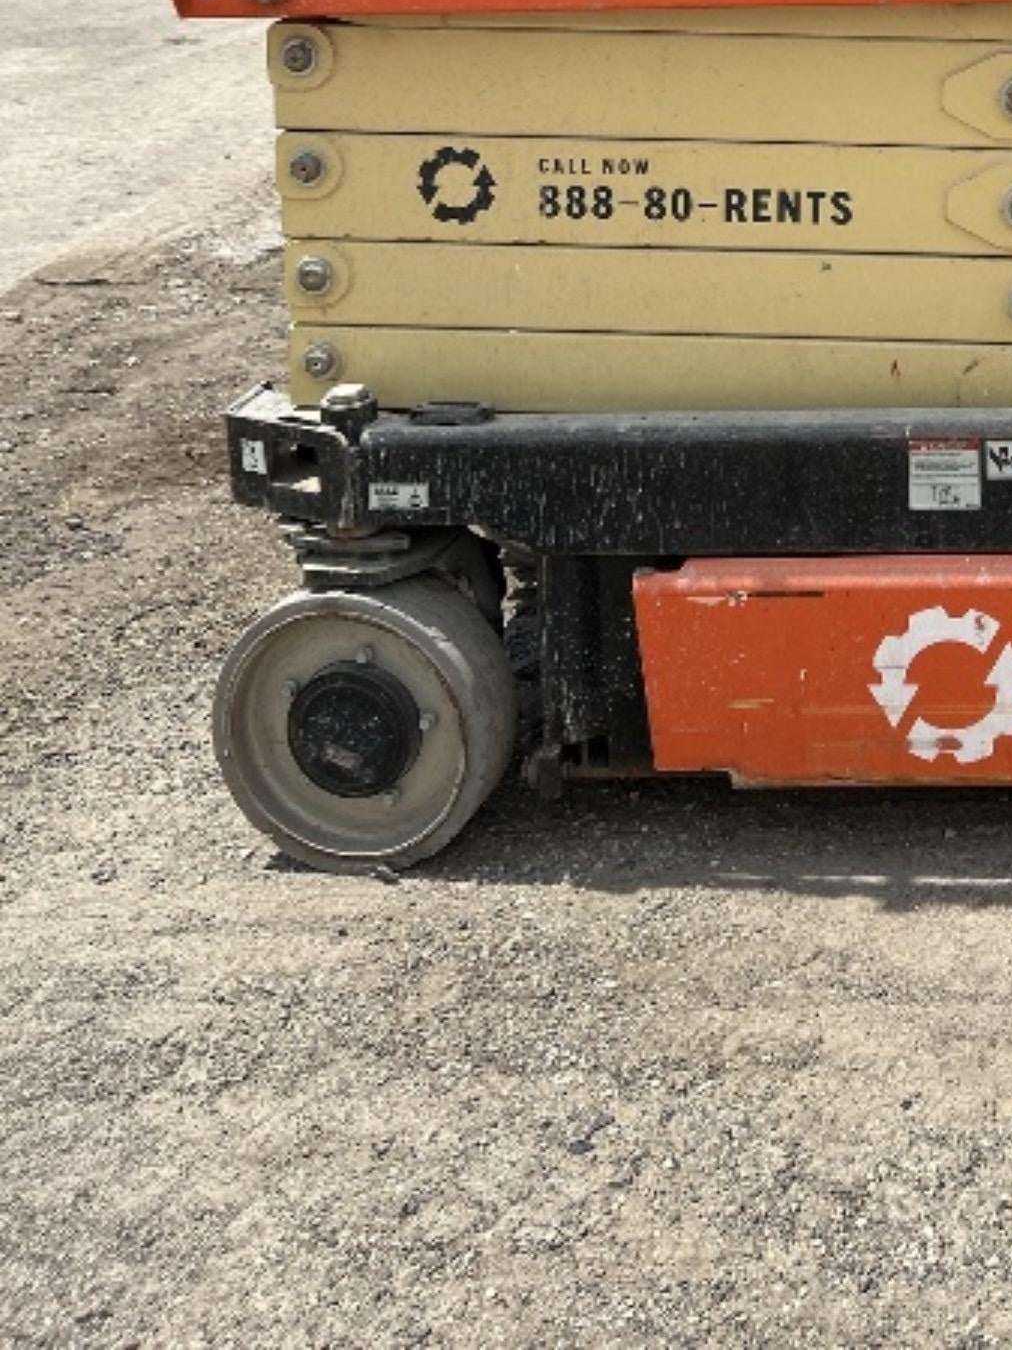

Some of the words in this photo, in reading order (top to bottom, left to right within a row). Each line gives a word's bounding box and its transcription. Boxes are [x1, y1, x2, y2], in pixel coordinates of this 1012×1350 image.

[538, 158, 592, 175] CALL
[602, 159, 650, 176] NOW
[538, 184, 853, 226] 888-80-RENTS
